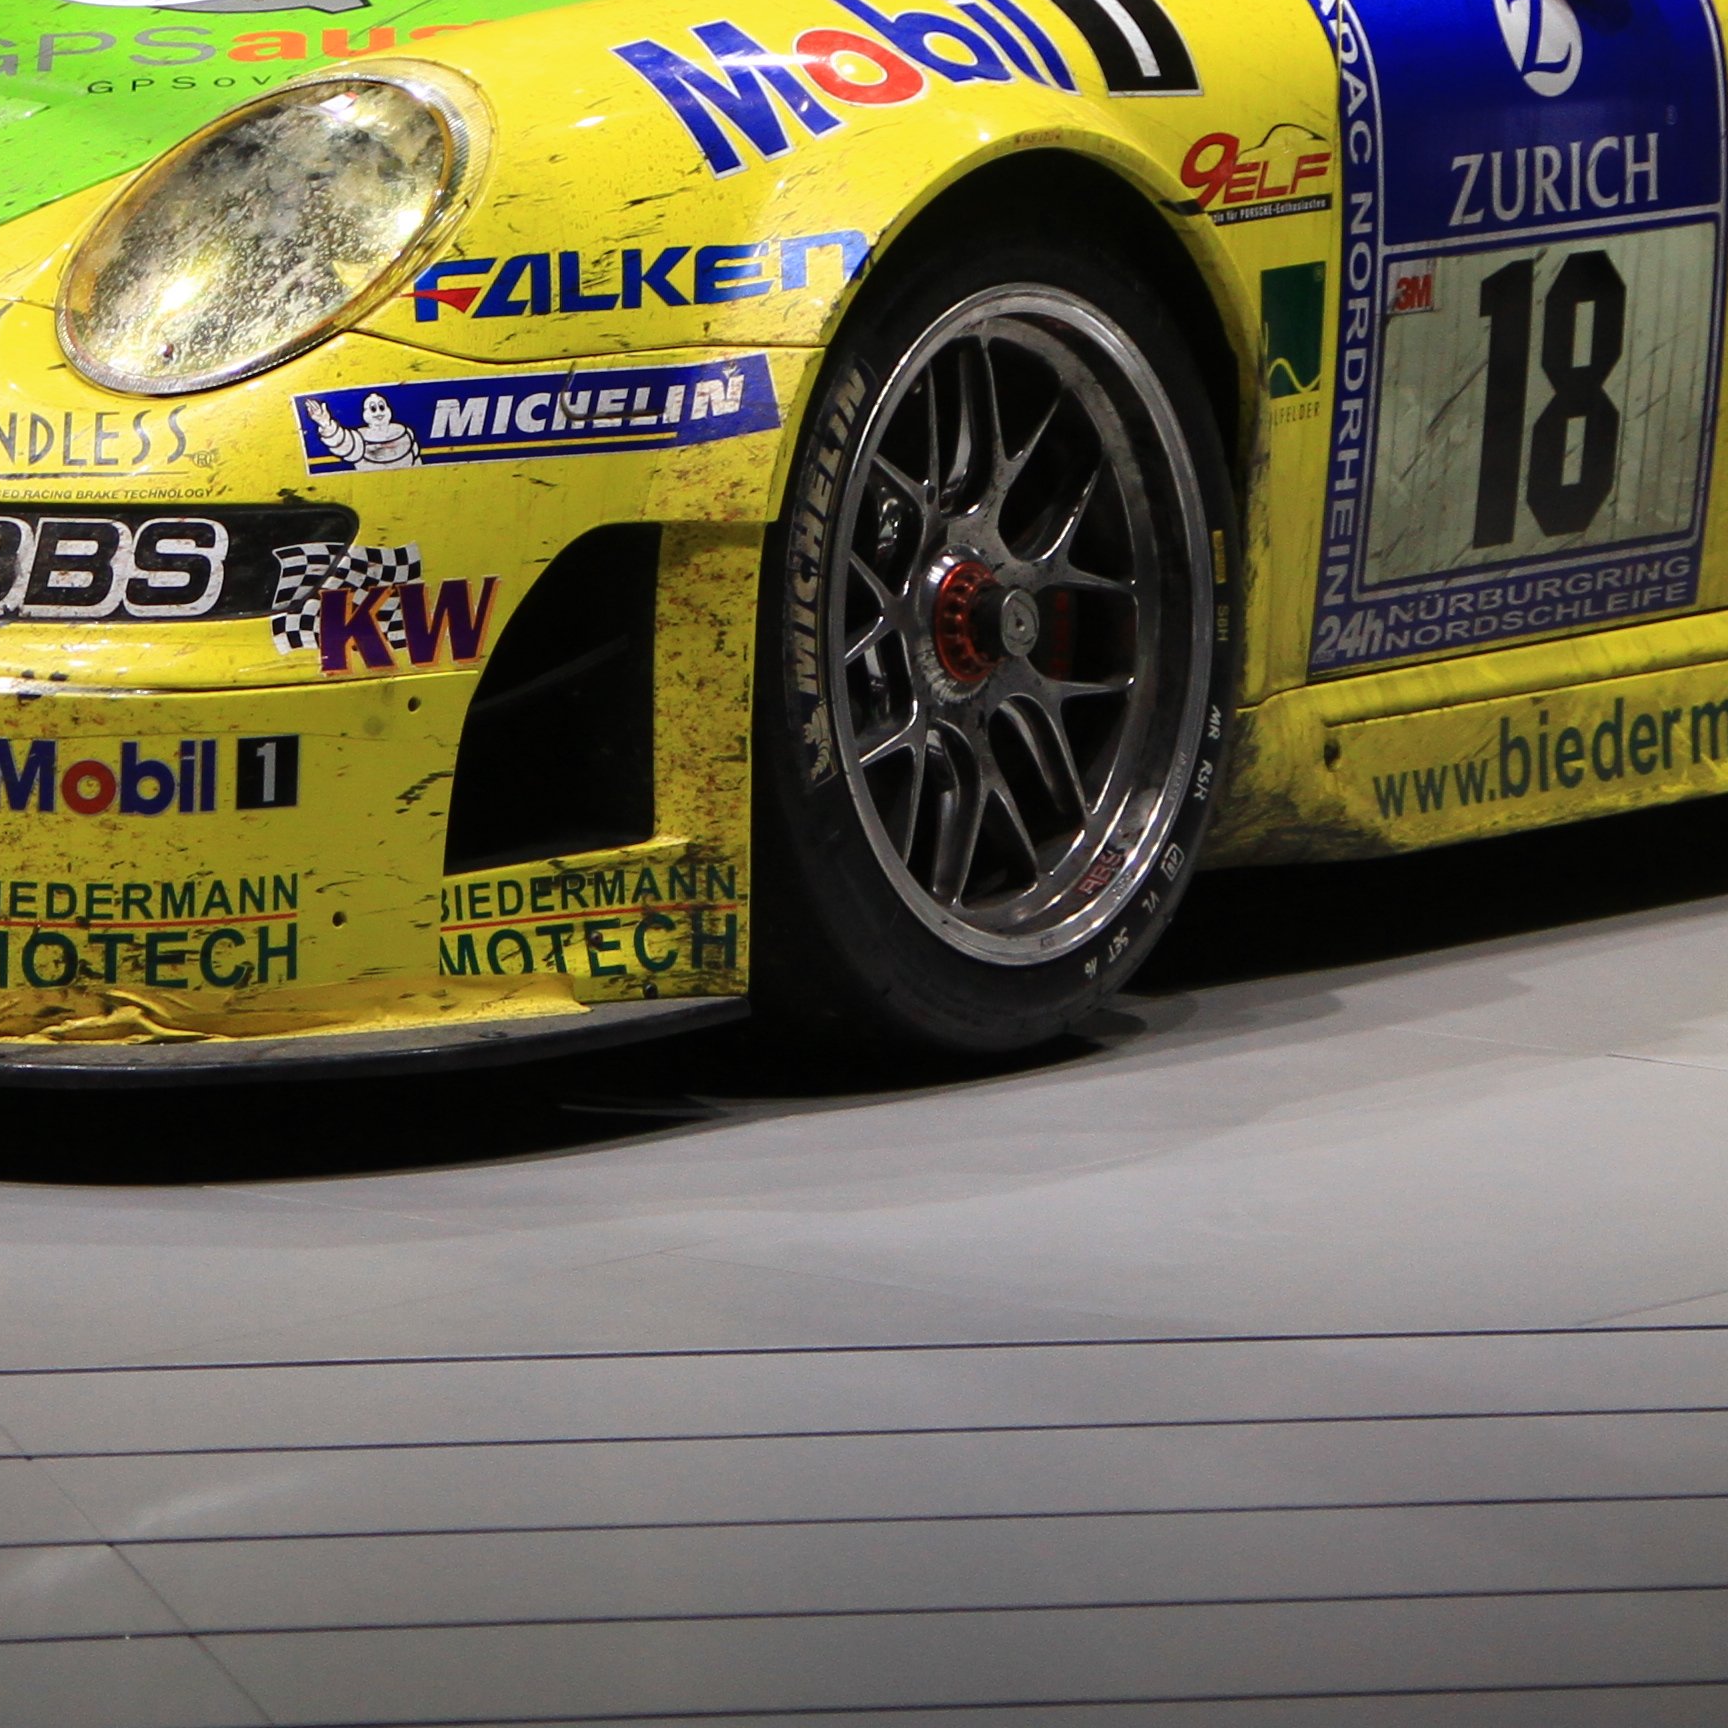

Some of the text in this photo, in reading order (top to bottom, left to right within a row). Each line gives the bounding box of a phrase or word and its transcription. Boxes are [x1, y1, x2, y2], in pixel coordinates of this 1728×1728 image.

[87, 72, 300, 96] GPSov
[1448, 132, 1662, 228] ZURICH
[1394, 270, 1434, 312] 3M
[428, 365, 746, 440] MICHELIN
[1321, 190, 1374, 608] NORDRHEIN
[1472, 249, 1628, 550] 18
[22, 488, 73, 500] RACING
[75, 488, 120, 500] BRAKE
[123, 487, 214, 500] TECHNOLOGY
[315, 573, 504, 676] KW
[1383, 580, 1689, 653] NORDSCHLEIFE
[1387, 556, 1692, 627] NÜRBURGRING
